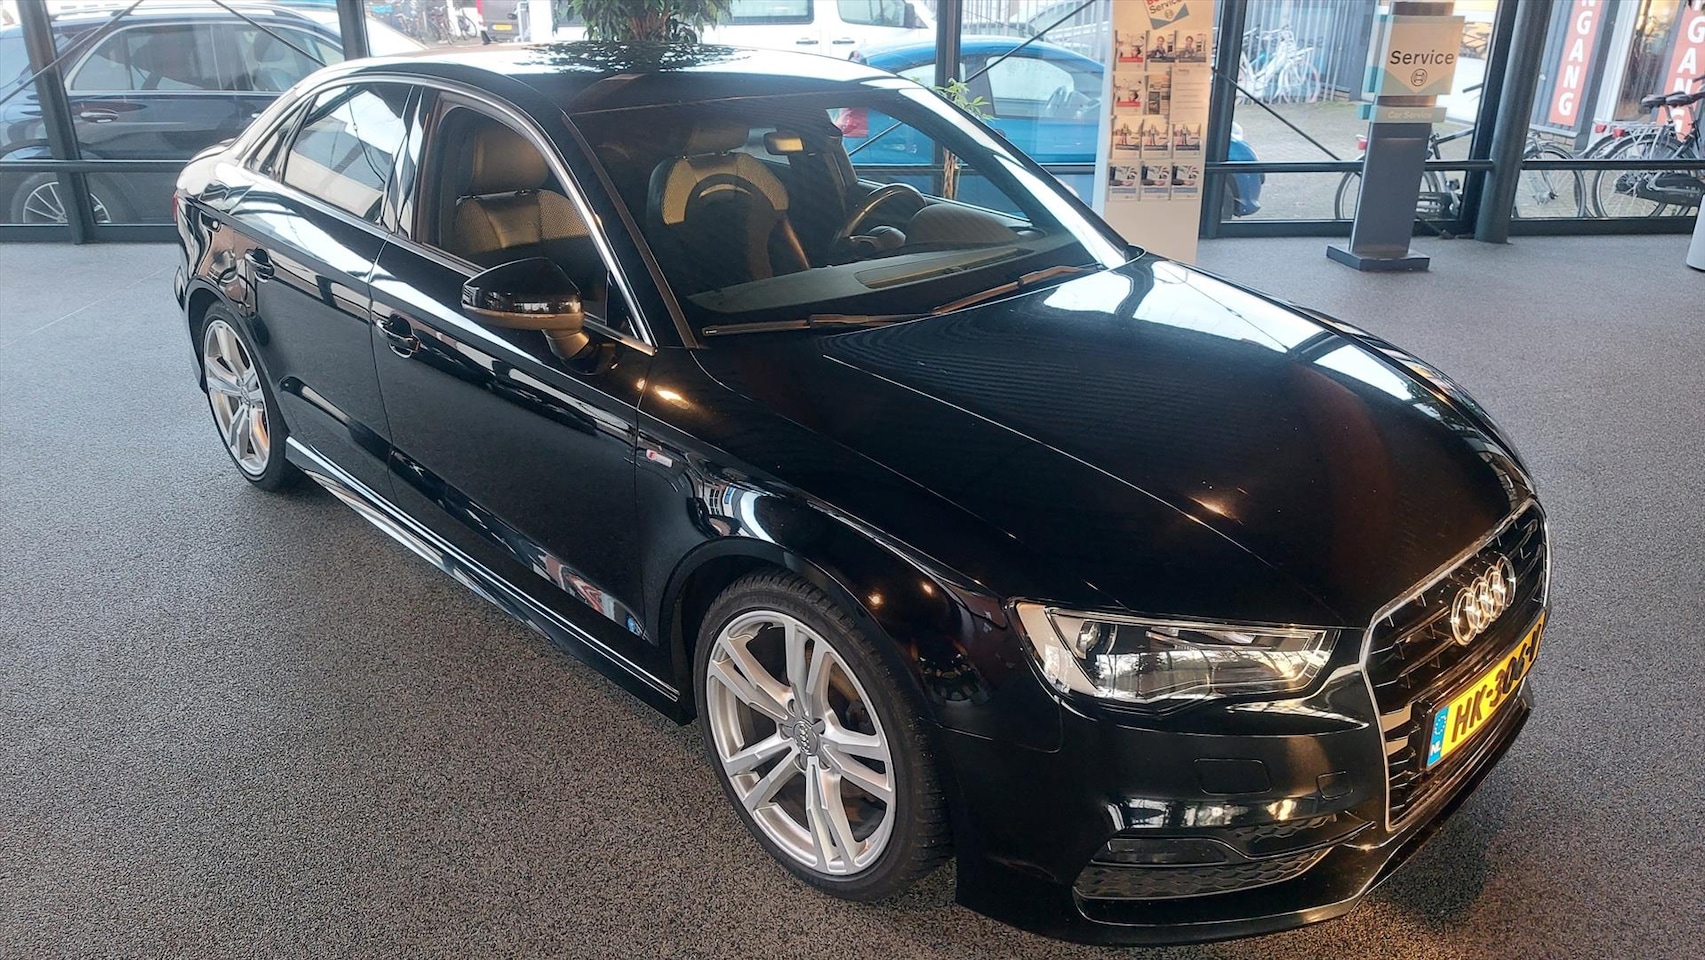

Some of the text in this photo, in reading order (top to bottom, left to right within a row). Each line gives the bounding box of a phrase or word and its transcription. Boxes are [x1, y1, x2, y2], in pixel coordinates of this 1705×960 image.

[1149, 0, 1181, 14] Servic
[1389, 49, 1455, 65] Service
[1558, 0, 1594, 116] GANG
[1404, 111, 1433, 119] Service
